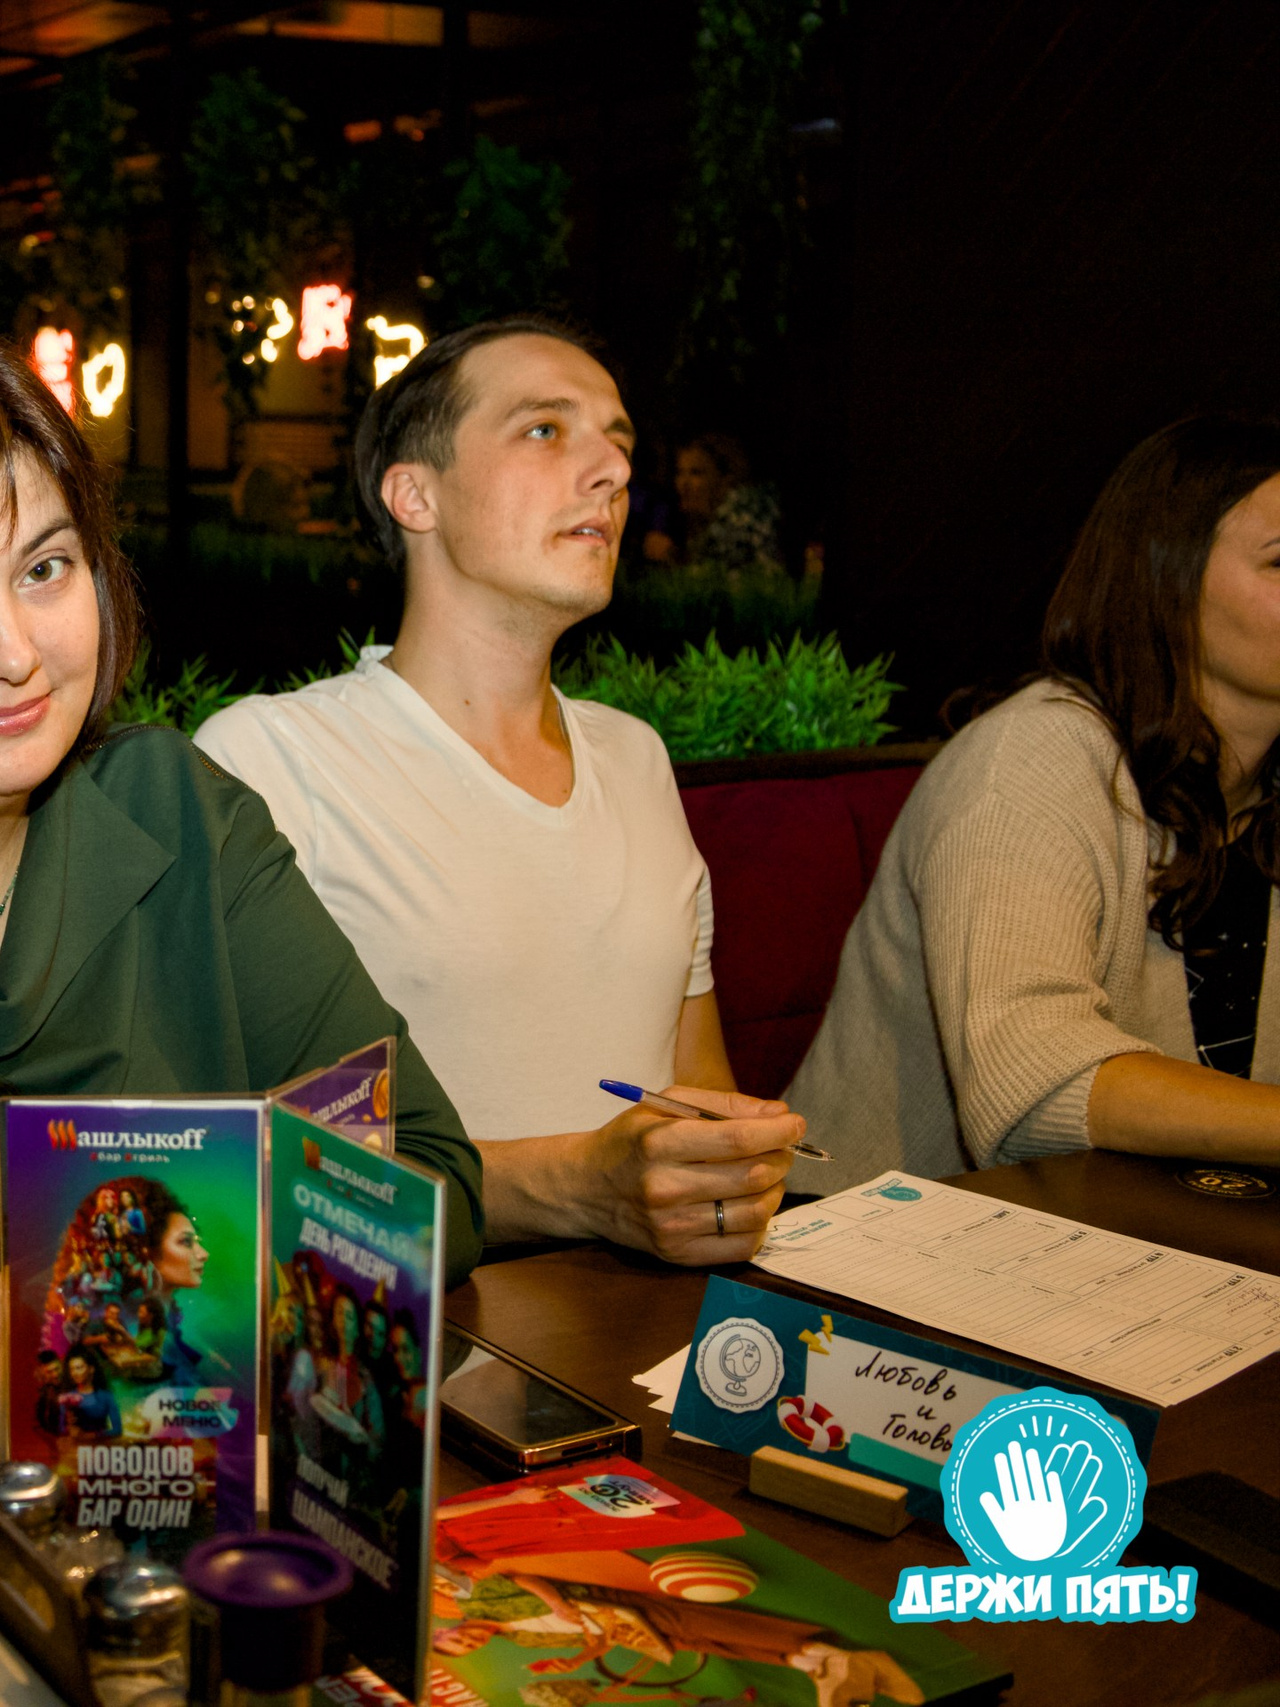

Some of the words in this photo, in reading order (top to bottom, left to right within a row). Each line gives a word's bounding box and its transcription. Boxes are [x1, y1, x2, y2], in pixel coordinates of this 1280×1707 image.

[855, 1351, 957, 1401] Любовь
[159, 1399, 222, 1412] НОВОЕ
[917, 1404, 937, 1420] и
[162, 1415, 221, 1428] МЕНЮ
[77, 1445, 195, 1480] ПОВОДОВ
[77, 1479, 195, 1497] МНОГО
[76, 1498, 122, 1527] БАР
[125, 1498, 193, 1531] ОДИН
